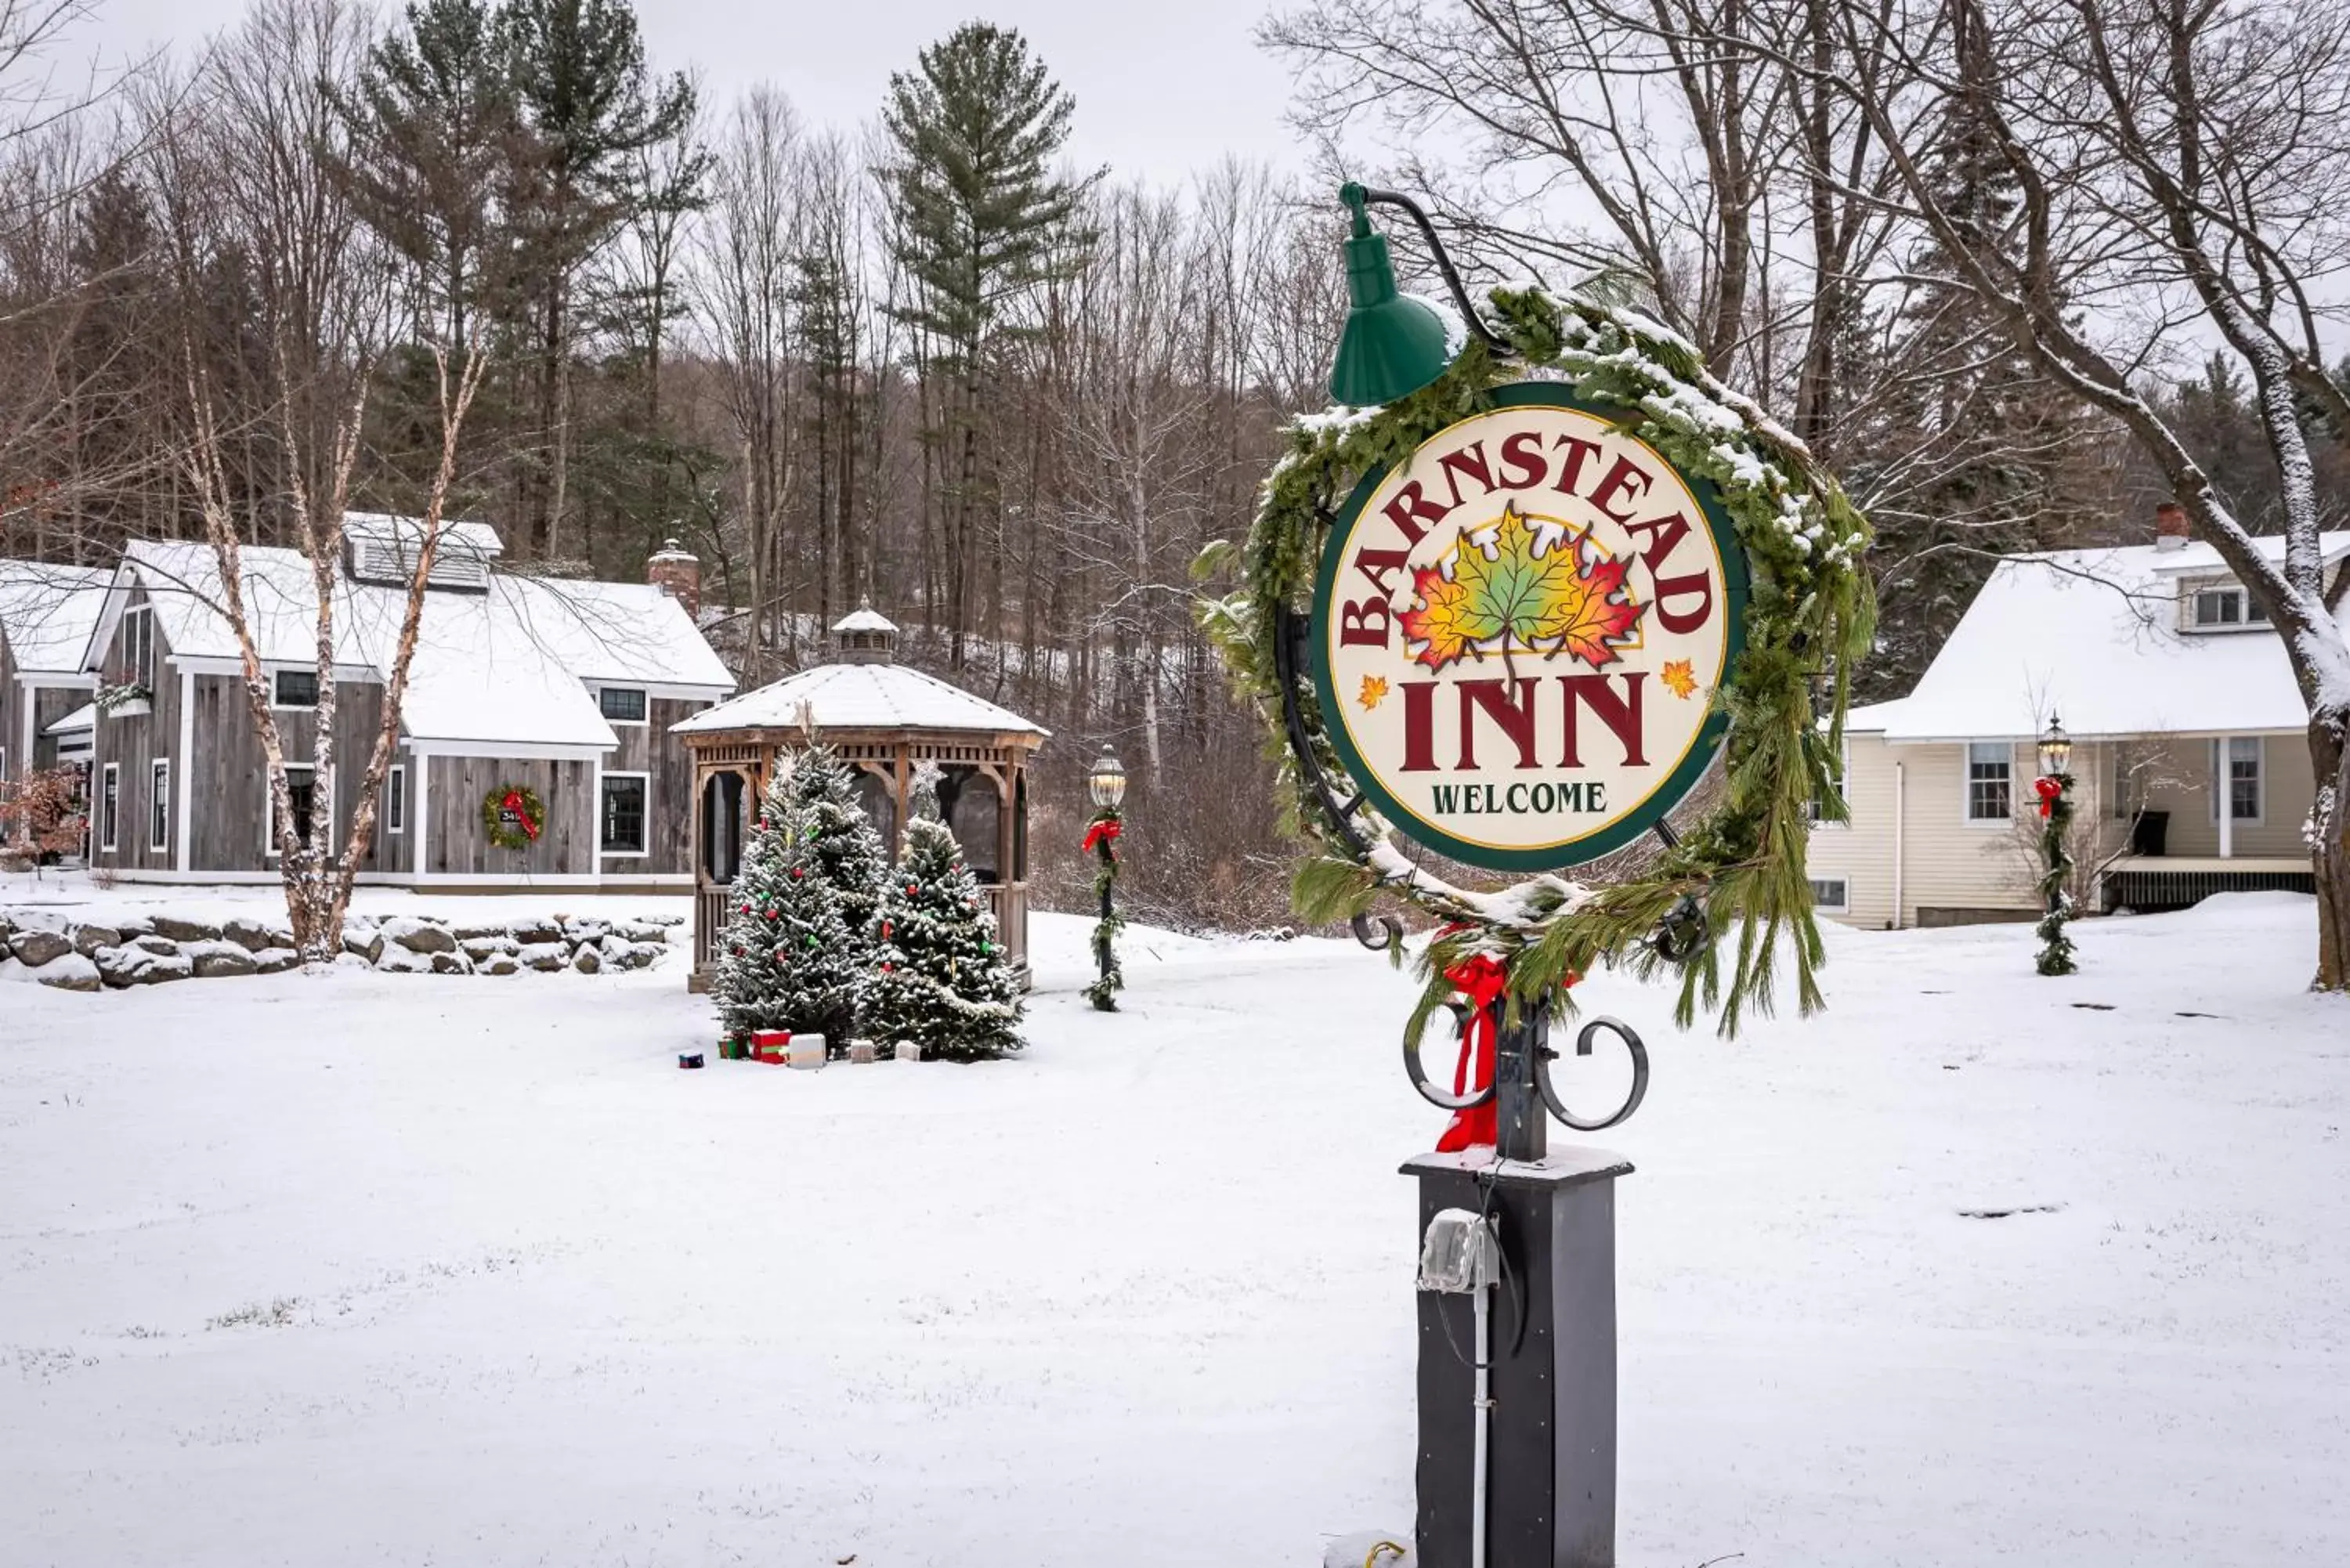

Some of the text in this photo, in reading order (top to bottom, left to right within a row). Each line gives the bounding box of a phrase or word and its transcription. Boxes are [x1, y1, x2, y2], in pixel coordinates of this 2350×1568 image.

[1340, 432, 1712, 649] BARNSTEAD
[1398, 672, 1650, 771] INN
[1432, 782, 1607, 815] WELCOME
